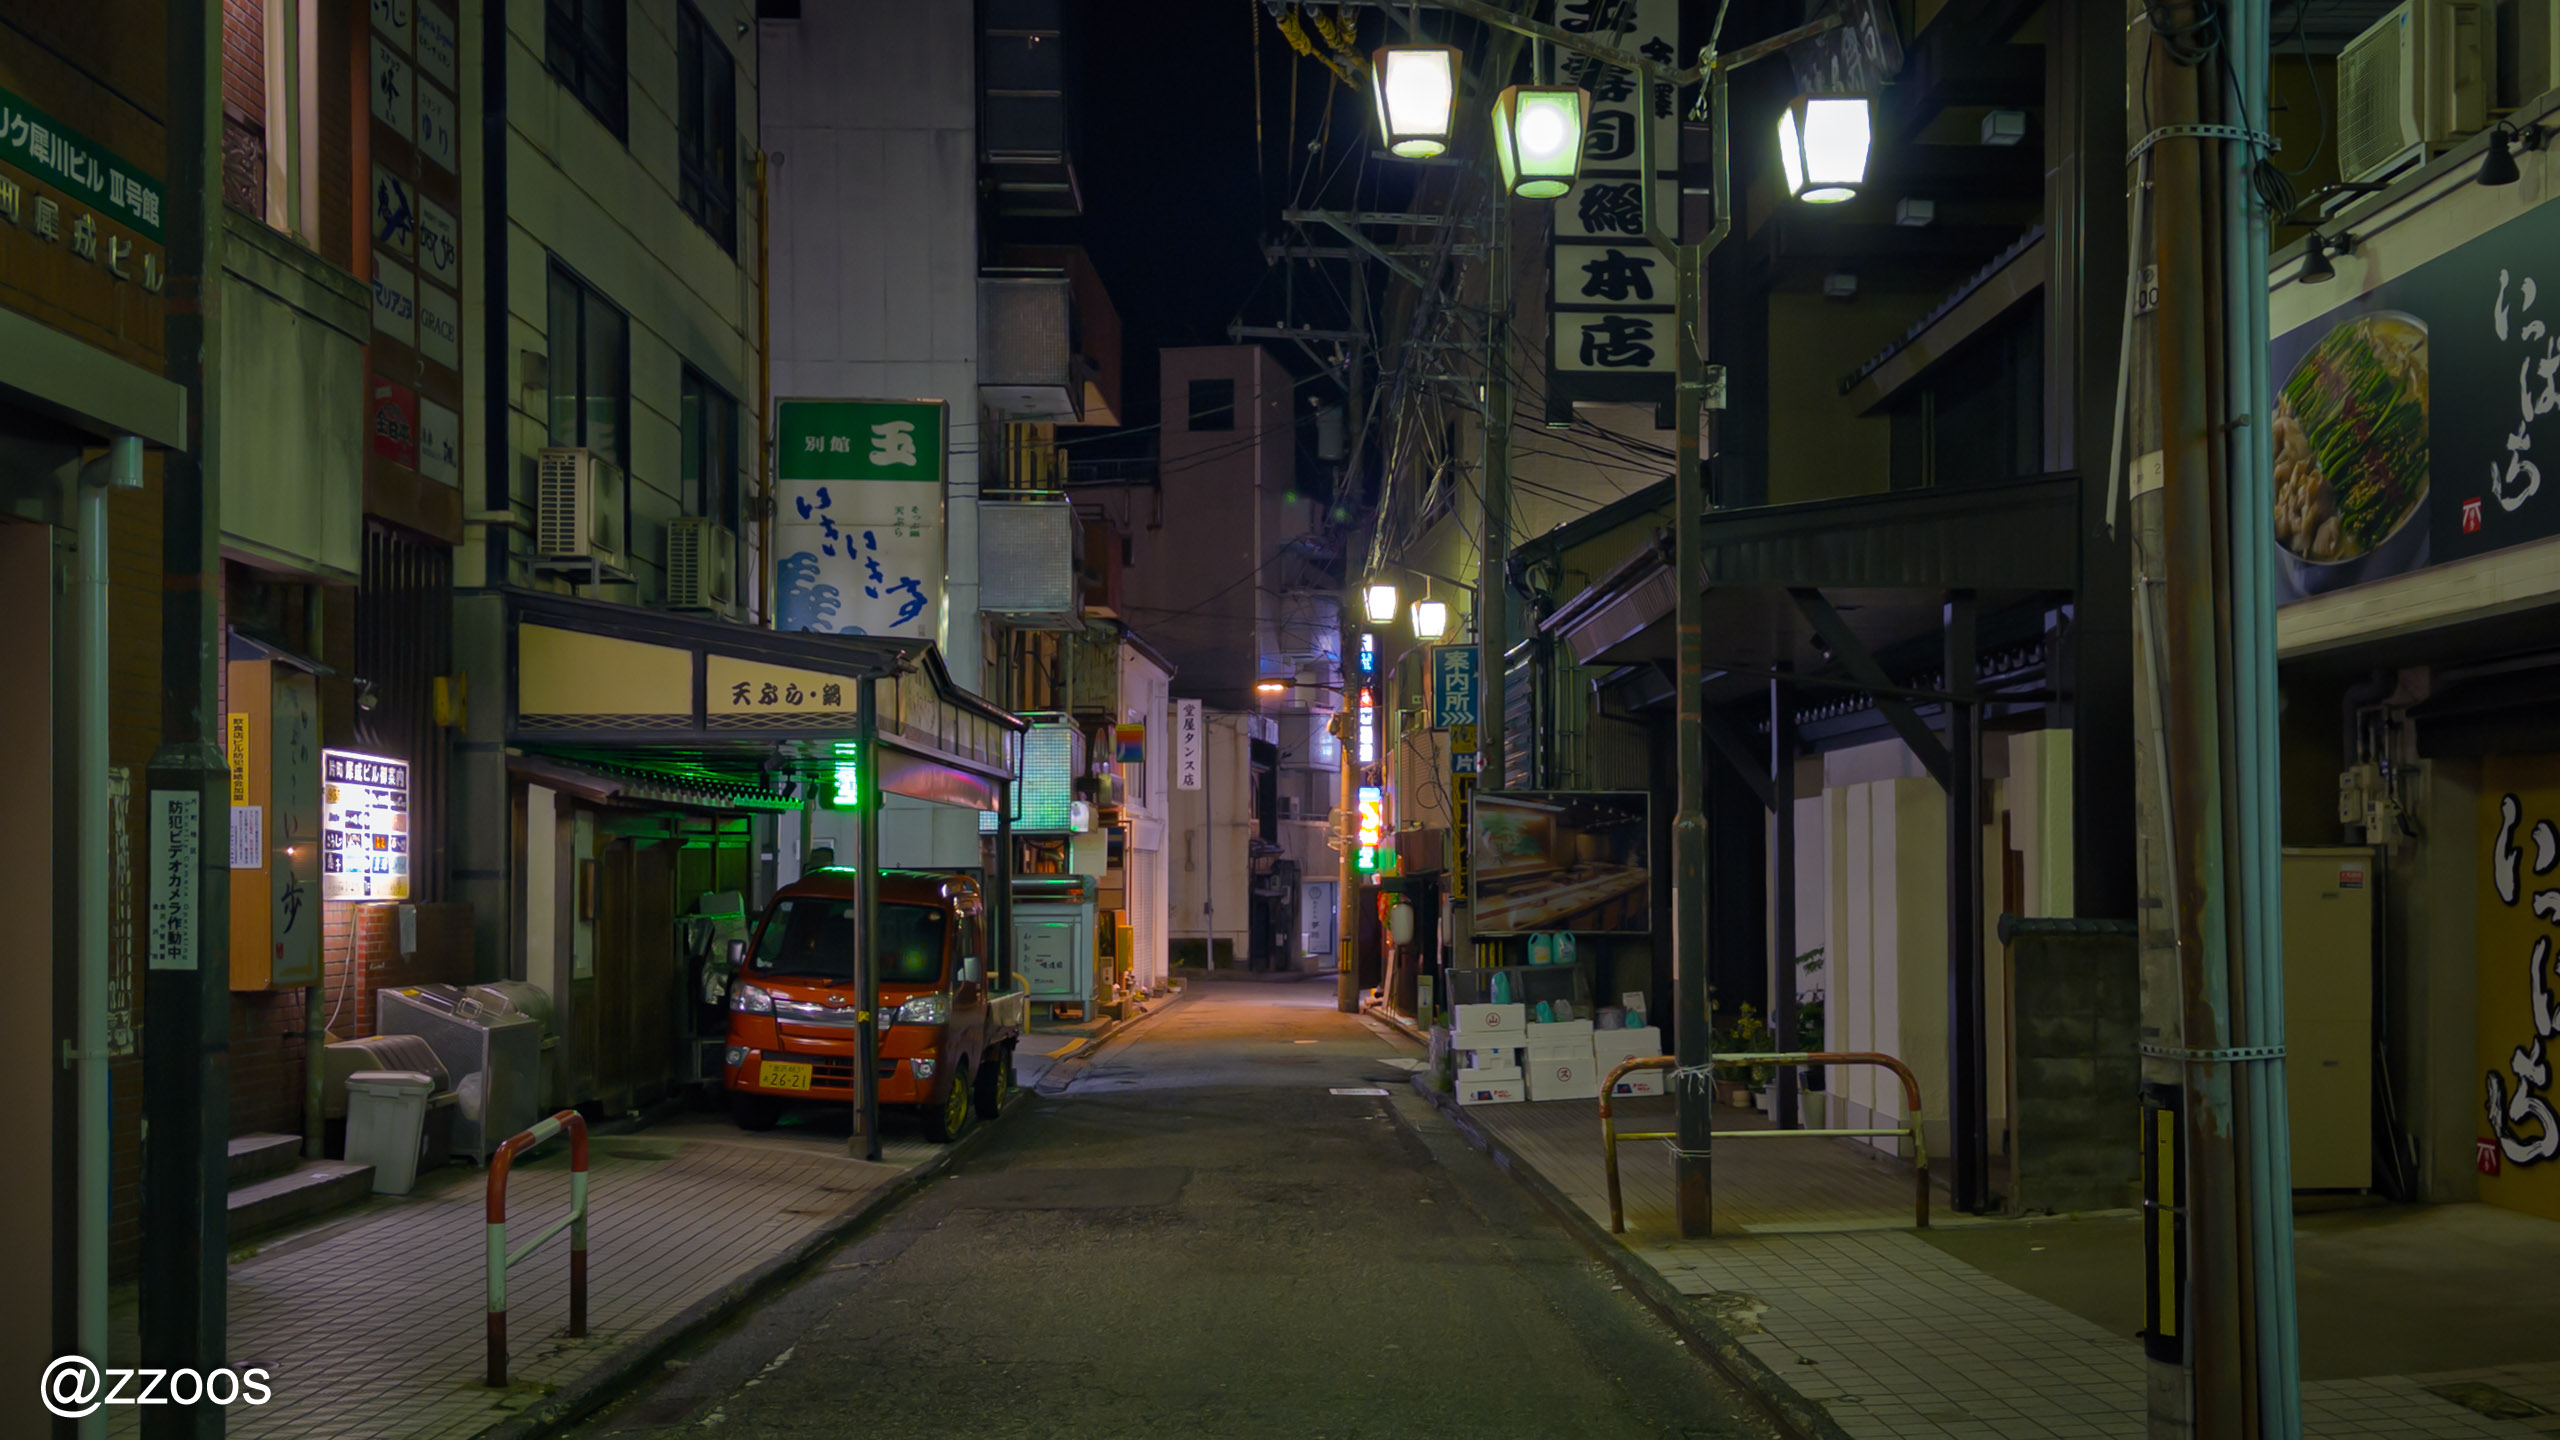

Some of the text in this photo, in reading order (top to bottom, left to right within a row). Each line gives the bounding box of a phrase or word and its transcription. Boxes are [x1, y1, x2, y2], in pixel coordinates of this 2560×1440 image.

[420, 308, 455, 342] GRACE
[804, 435, 851, 453] 別館
[894, 505, 904, 538] 天ぷら
[1444, 650, 1471, 711] 案内所
[1183, 703, 1196, 786] 堂屋タンス店
[1456, 755, 1478, 772] 片
[168, 800, 183, 960] 防犯ビデオカメラ作動中
[770, 1073, 806, 1088] 26-21
